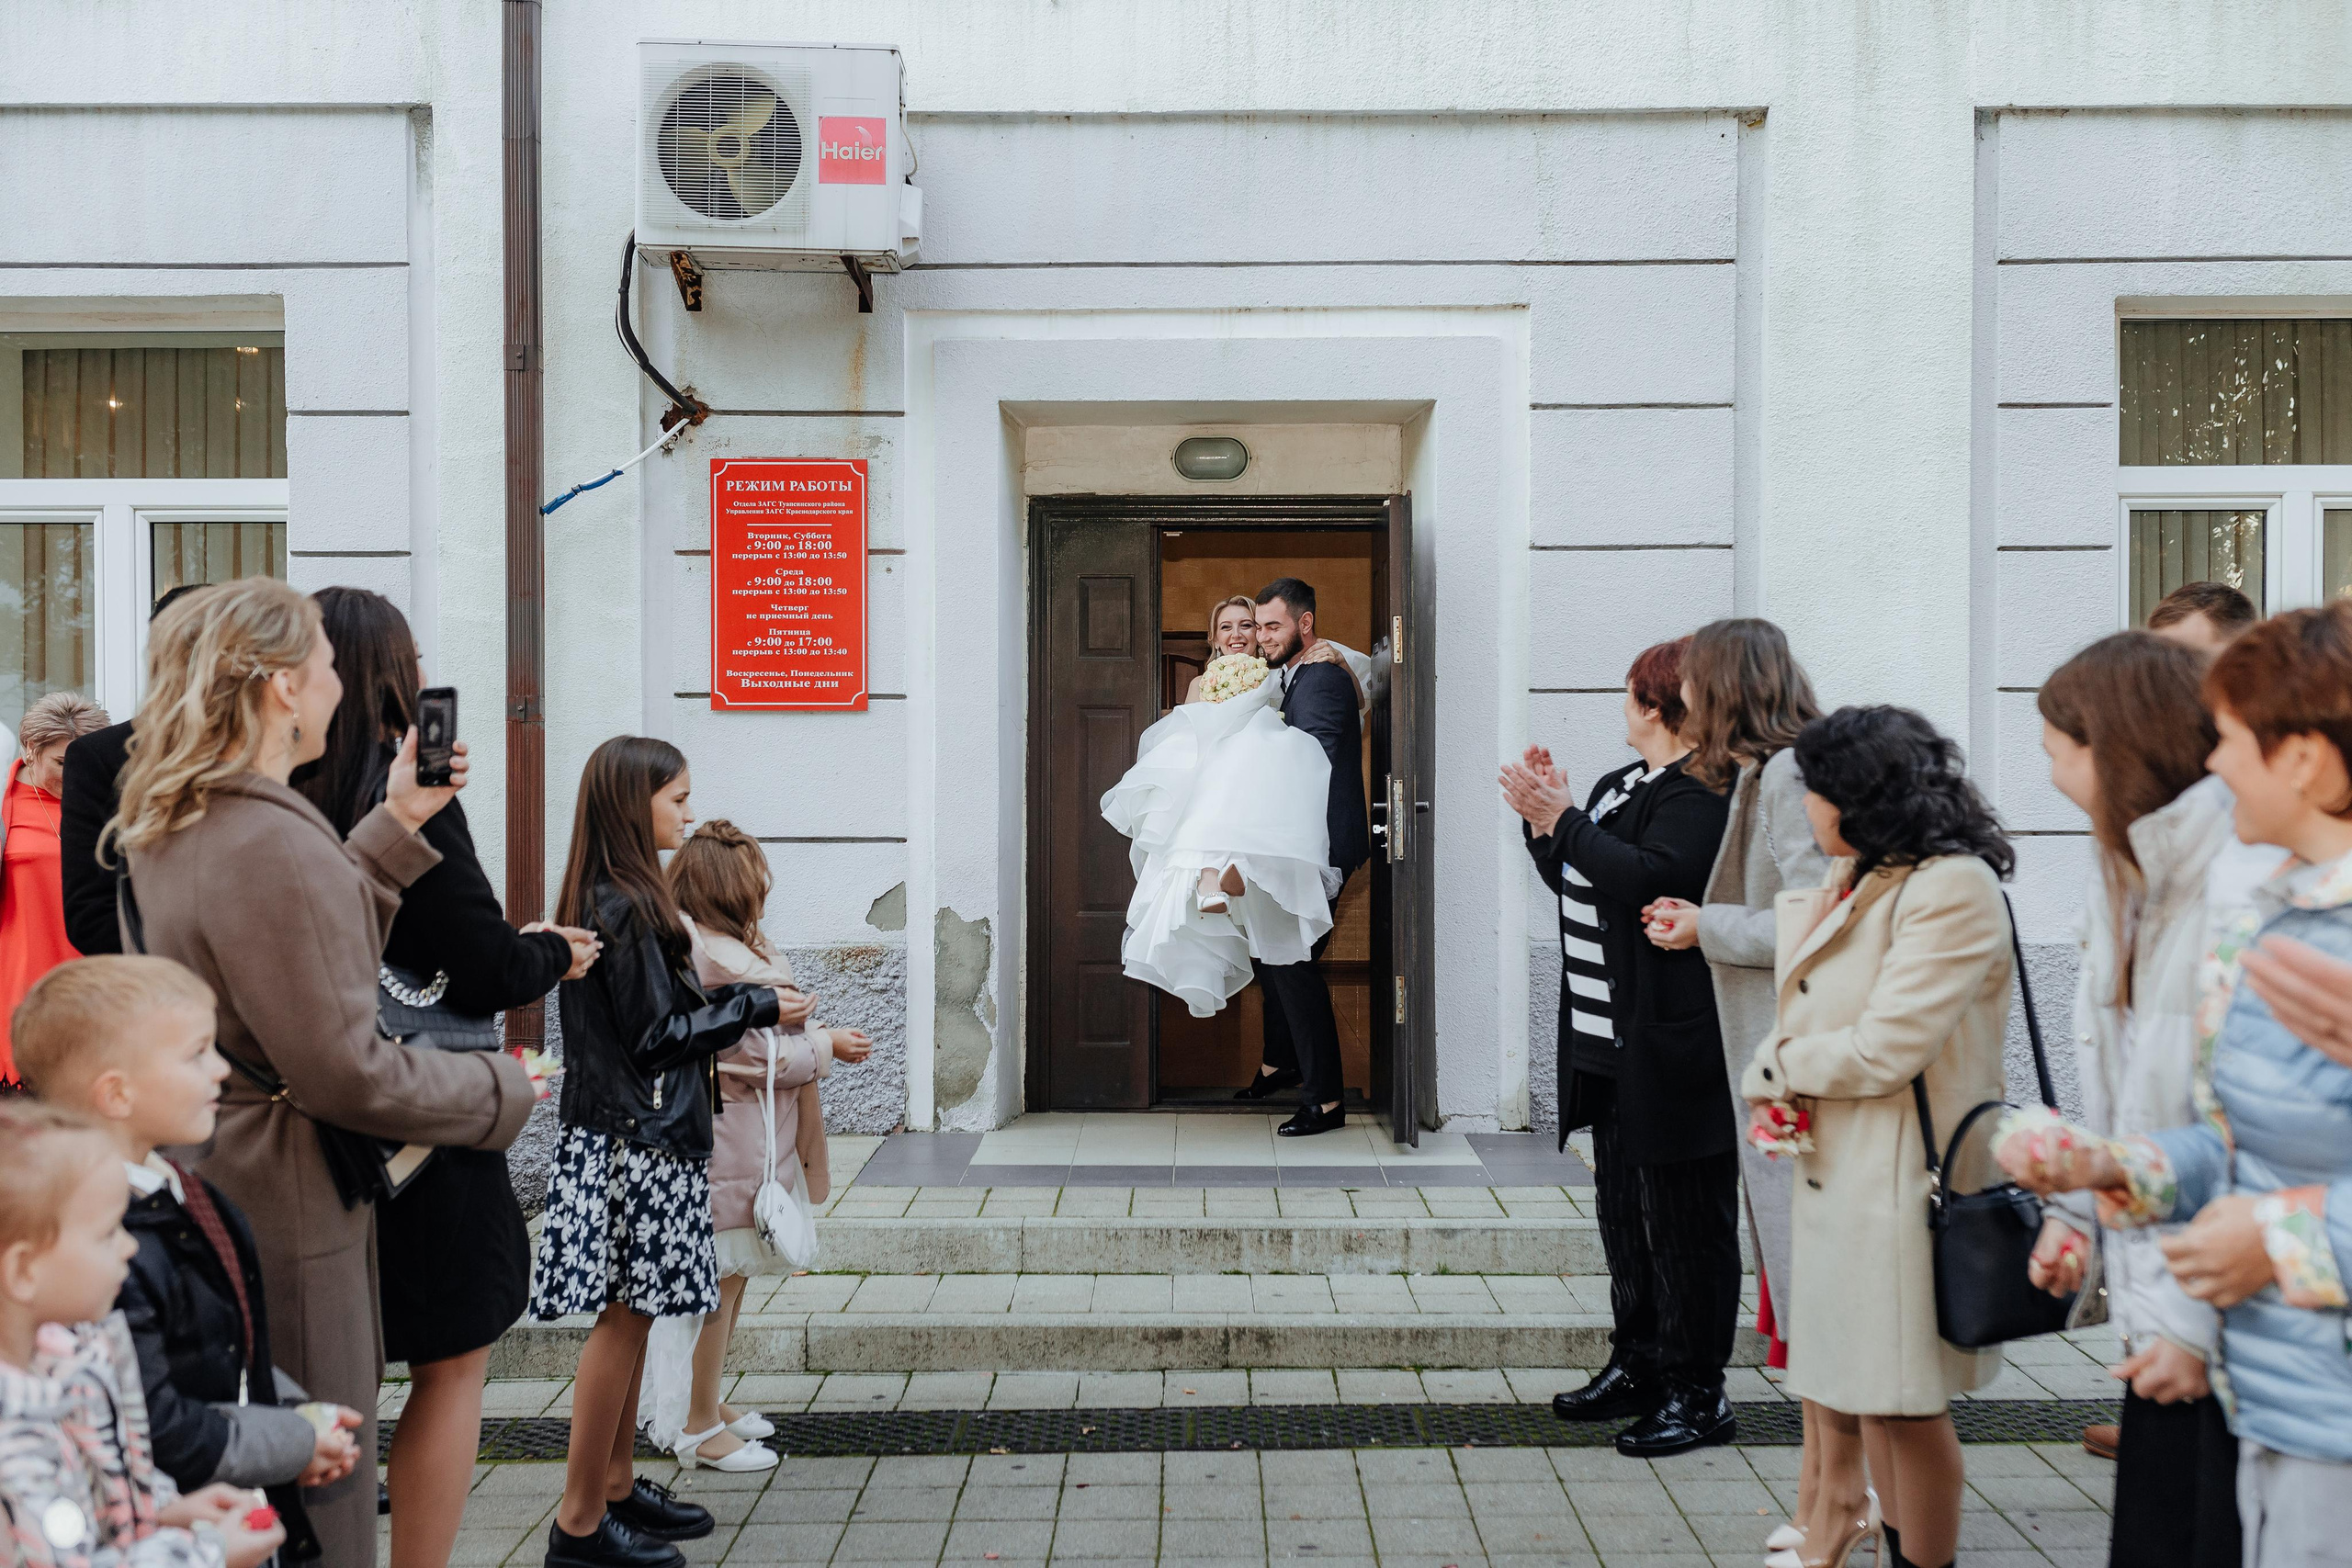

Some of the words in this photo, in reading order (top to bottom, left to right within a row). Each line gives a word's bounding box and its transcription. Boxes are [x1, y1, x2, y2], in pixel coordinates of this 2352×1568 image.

[820, 140, 883, 161] Haier
[726, 480, 785, 491] РЕЖИМ
[789, 480, 852, 491] РАБОТЫ
[754, 541, 781, 549] 9:00
[798, 540, 831, 550] 18:00
[754, 577, 781, 586] 9:00
[798, 577, 832, 586] 18:00
[771, 604, 808, 613] Четверг
[754, 637, 782, 646] 9:00
[798, 637, 832, 646] 17:00
[727, 670, 787, 678] Воскресенье,
[741, 679, 810, 688] Выходные
